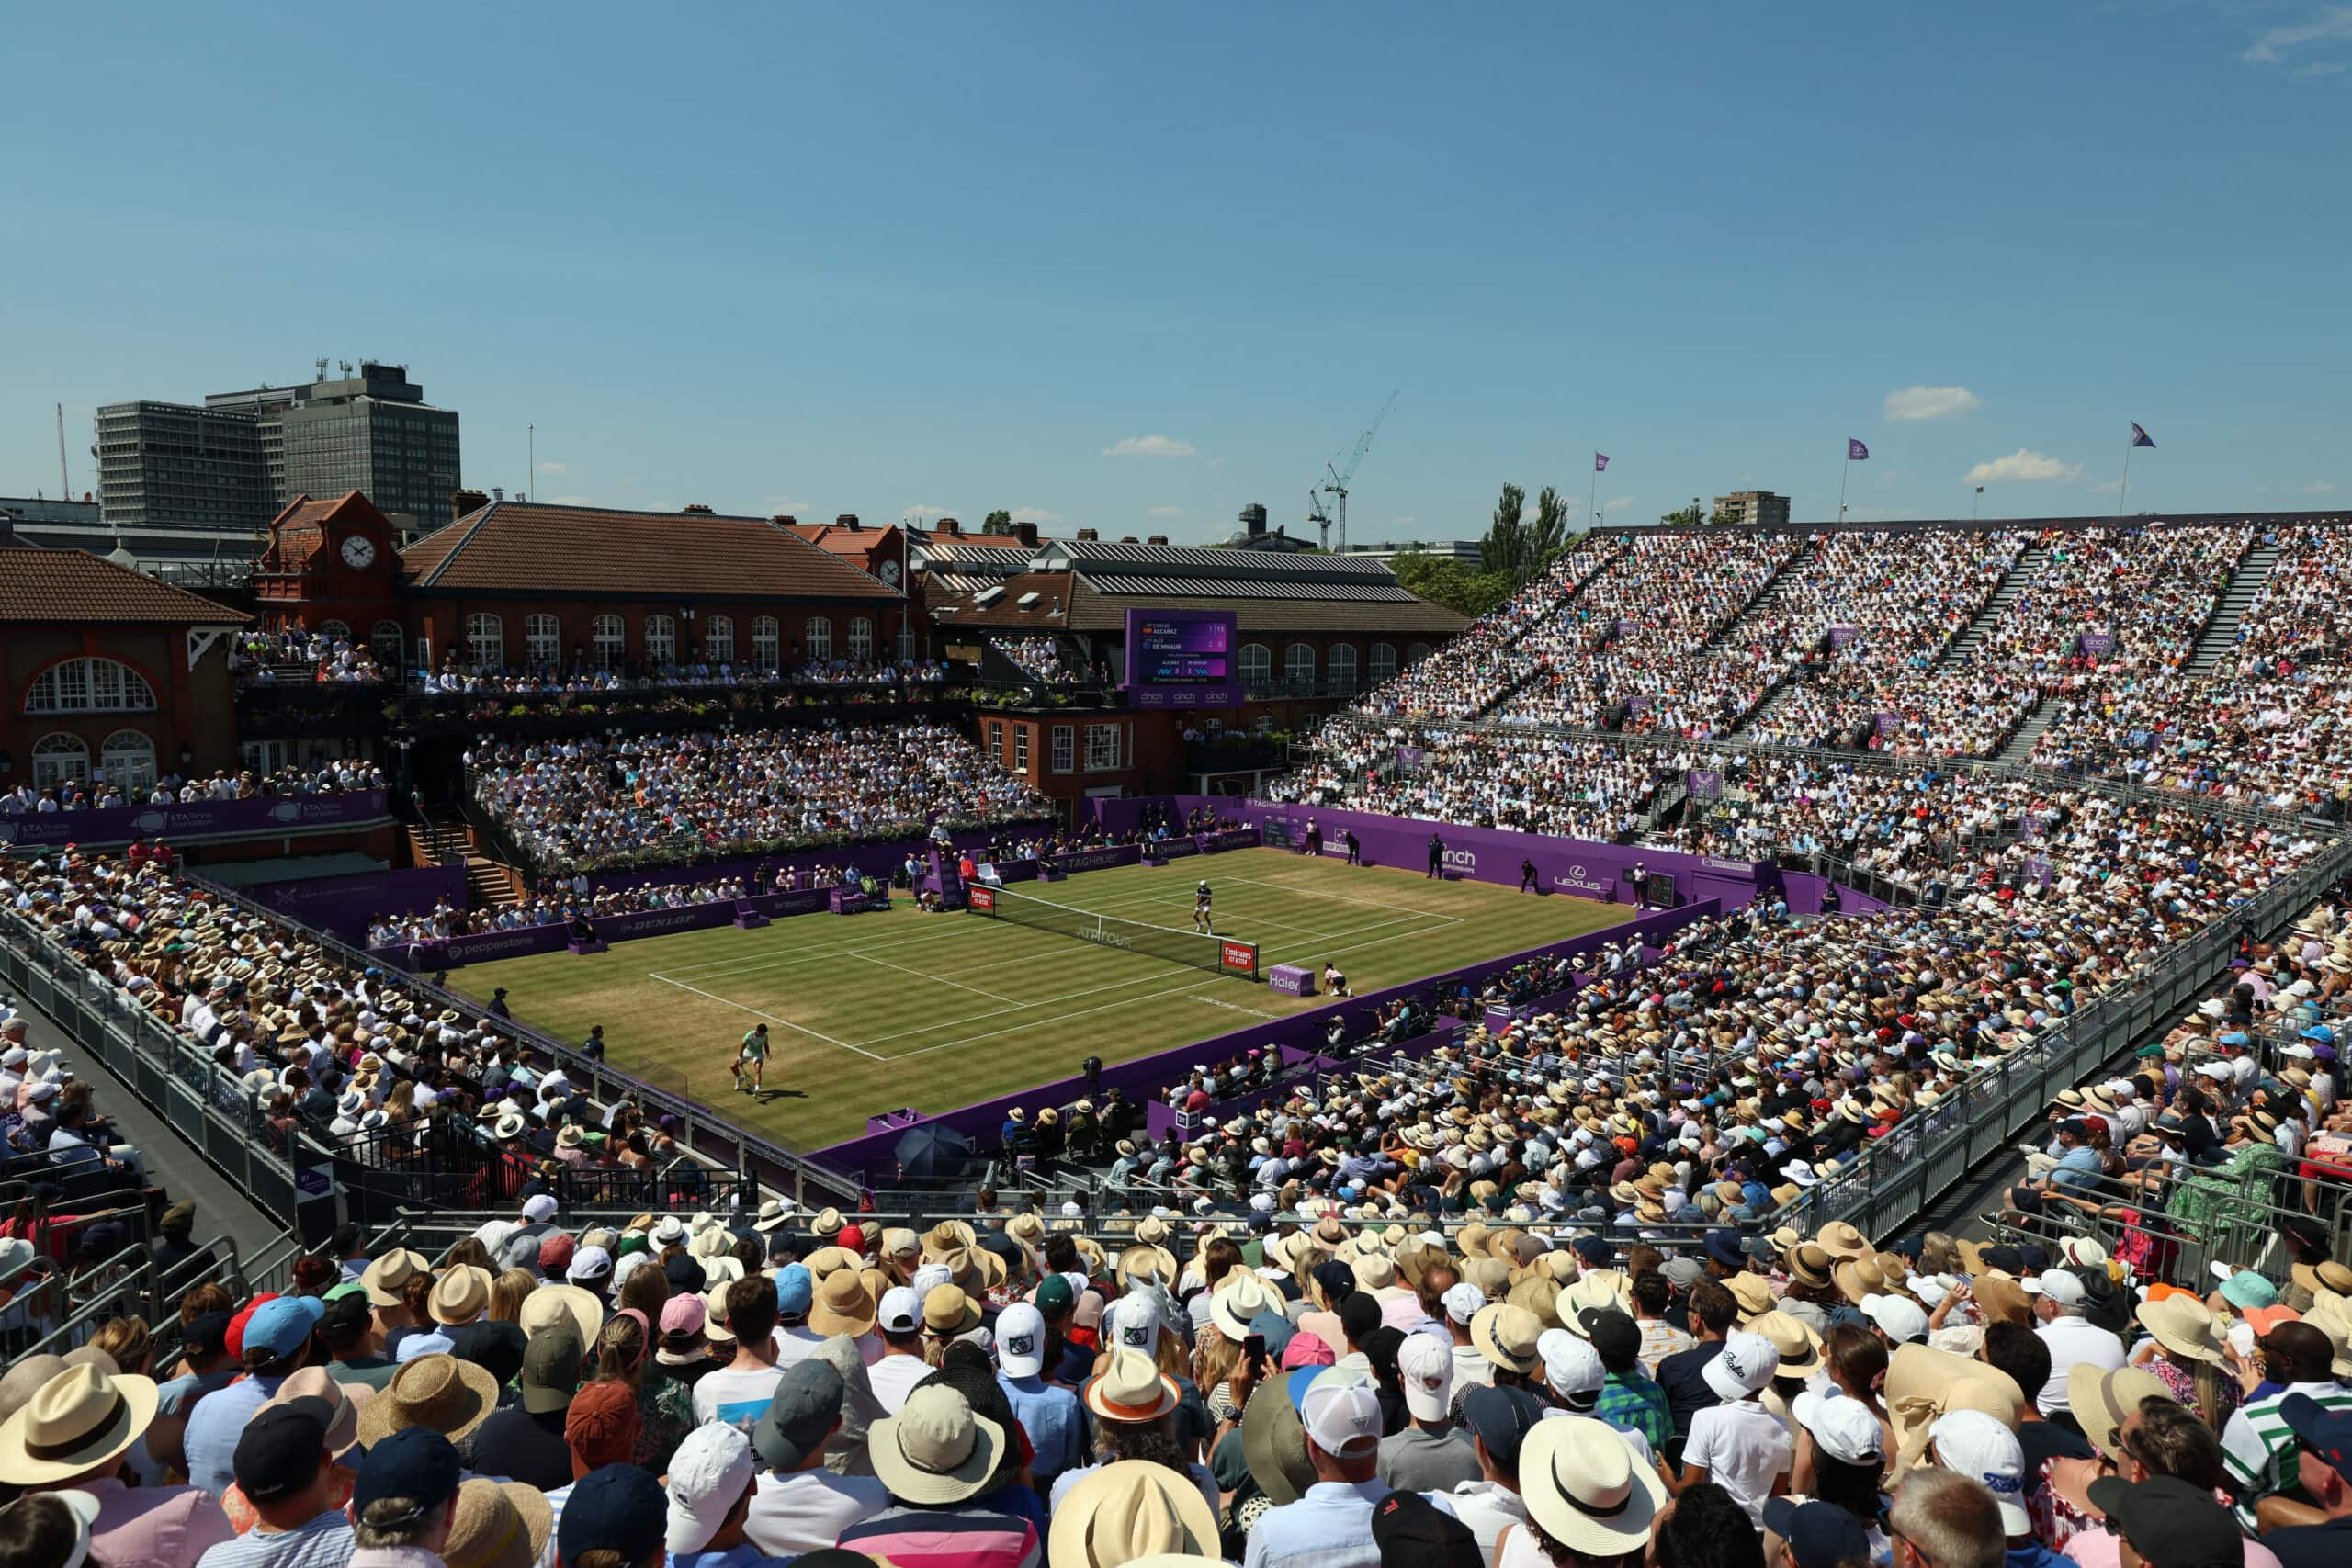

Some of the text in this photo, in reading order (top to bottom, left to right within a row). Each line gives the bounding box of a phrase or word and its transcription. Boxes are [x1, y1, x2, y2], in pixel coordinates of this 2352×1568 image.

[1140, 691, 1163, 700] cinch
[1173, 692, 1195, 700] cinch
[1205, 690, 1227, 700] cinch
[303, 803, 321, 811] LTA
[170, 813, 187, 822] LTA
[22, 823, 42, 832] LTA
[1442, 843, 1476, 866] inch
[1554, 875, 1600, 890] LEXUS
[971, 889, 991, 901] Emirates
[631, 914, 695, 931] DUNLOP
[464, 935, 534, 956] pepperstone
[1102, 931, 1132, 949] TOUR
[1225, 946, 1251, 959] Emirates
[1269, 973, 1300, 991] Haier
[1724, 1350, 1746, 1379] Italia
